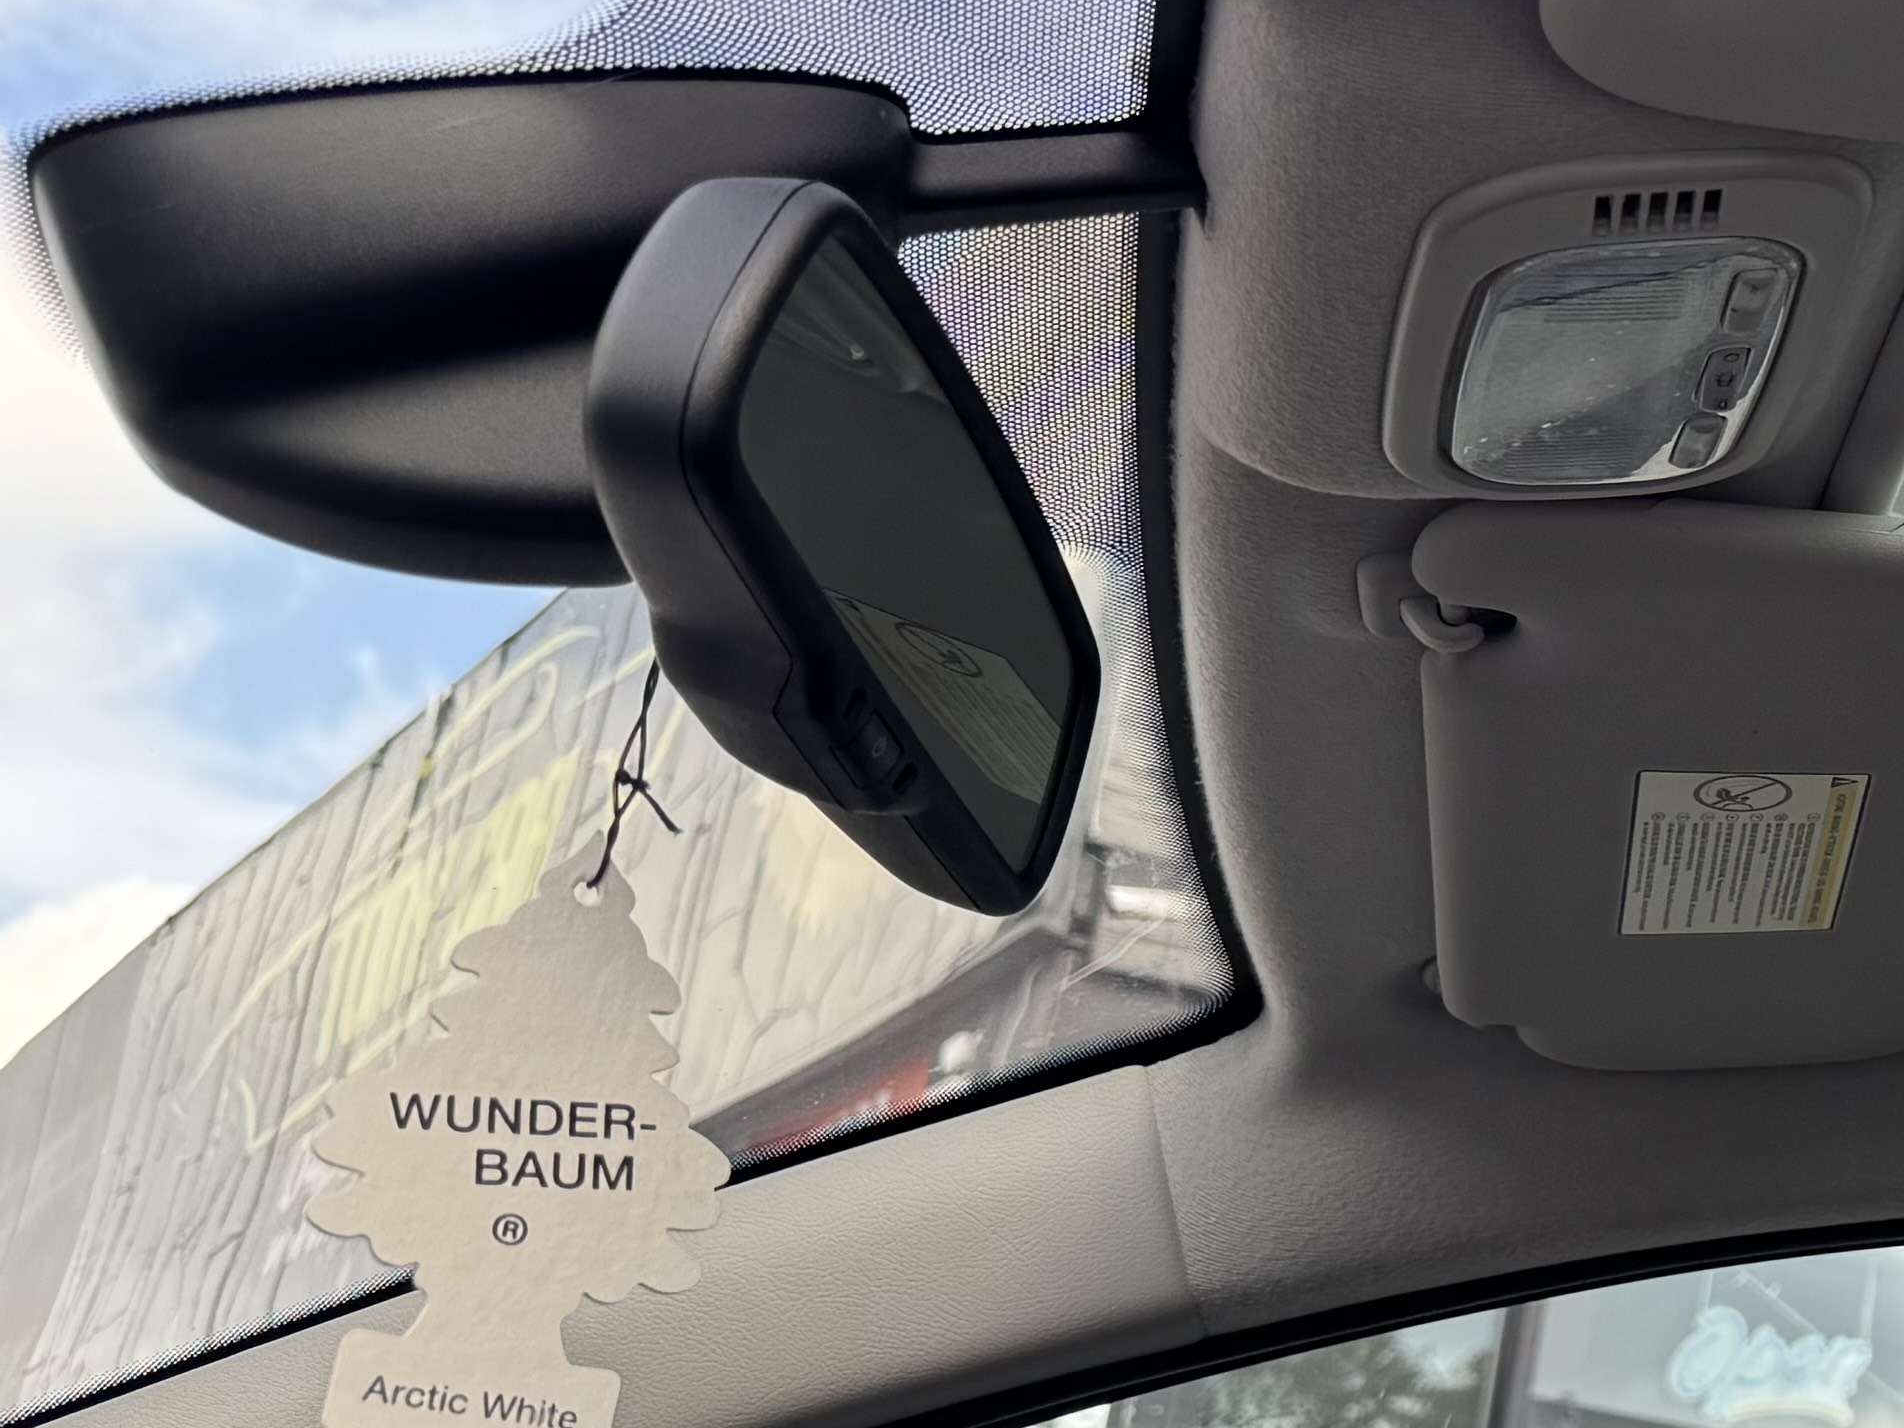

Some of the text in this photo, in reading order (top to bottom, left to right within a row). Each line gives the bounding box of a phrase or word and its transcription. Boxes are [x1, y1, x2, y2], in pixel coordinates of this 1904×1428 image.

[389, 1091, 657, 1141] WUNDER-
[475, 1148, 635, 1192] BAUM
[362, 1374, 469, 1416] Arctic
